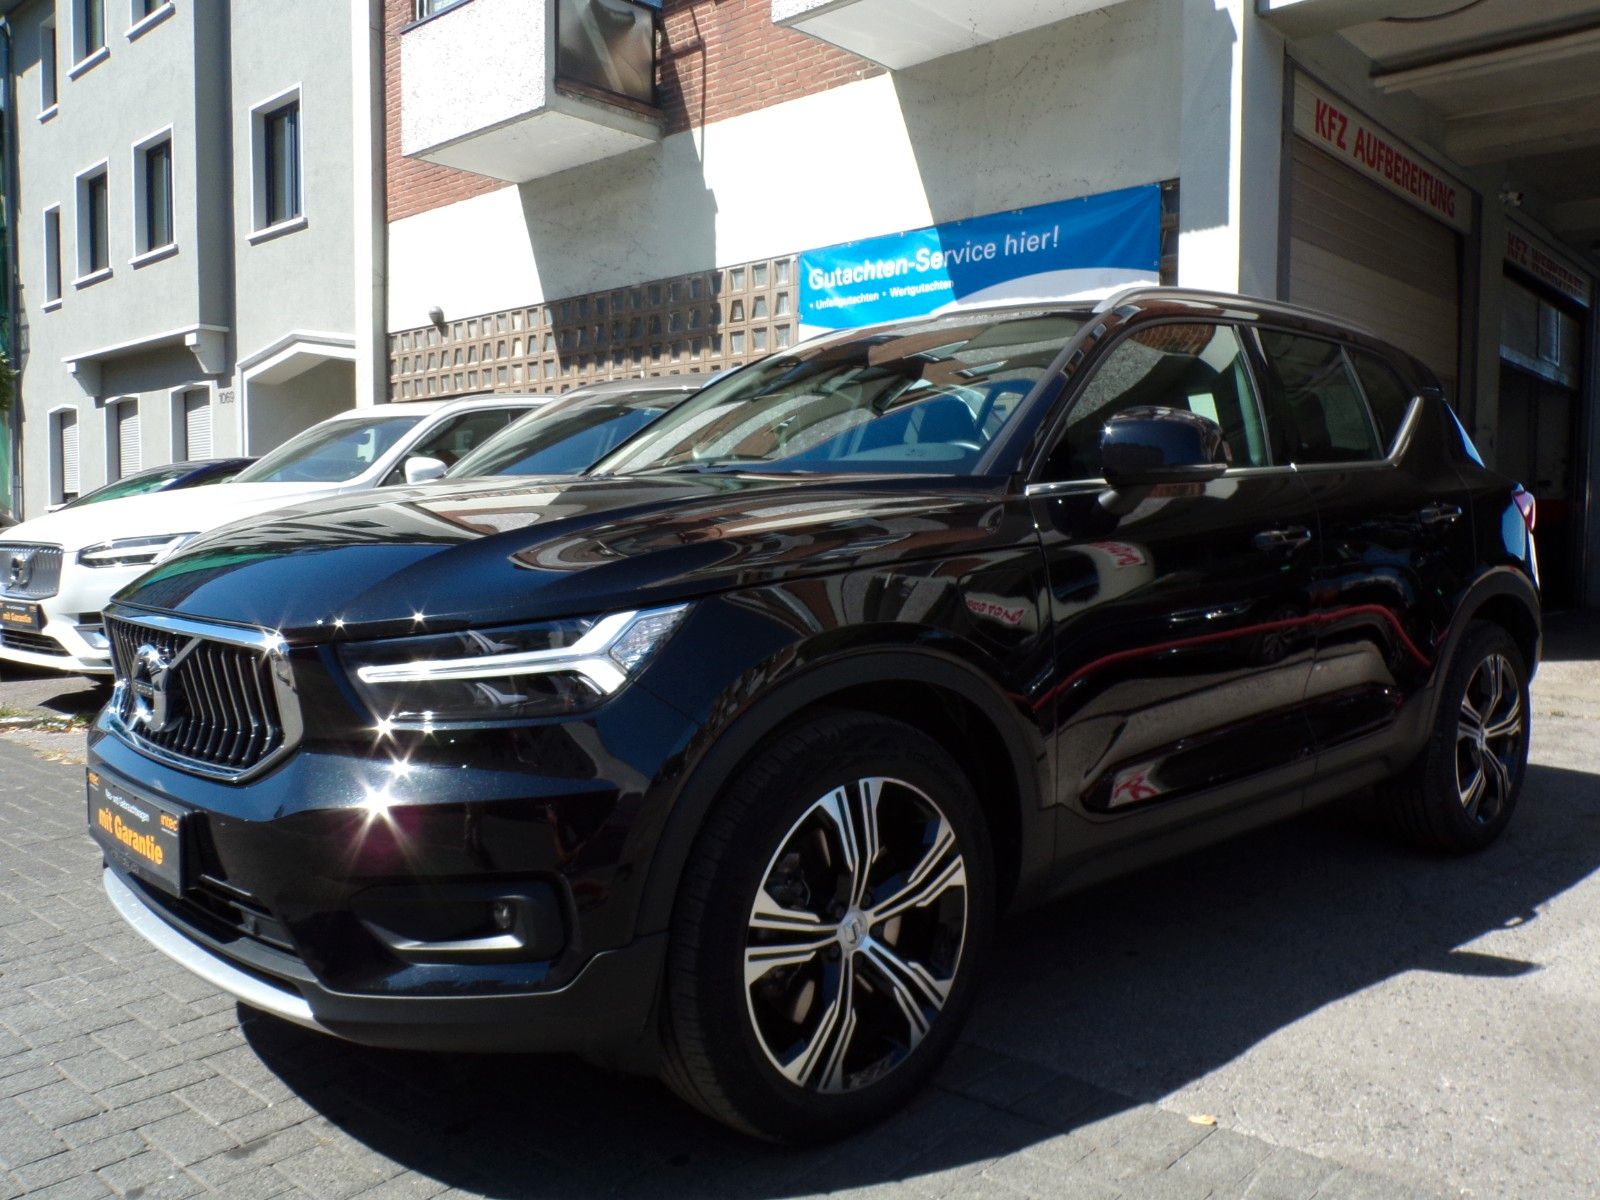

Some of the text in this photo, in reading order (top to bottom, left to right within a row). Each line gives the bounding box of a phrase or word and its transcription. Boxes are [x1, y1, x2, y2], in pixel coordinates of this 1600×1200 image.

[1315, 98, 1456, 218] KFZ AUFBEREITUNG
[809, 224, 1059, 290] Gutachten-Service hier!
[889, 280, 954, 298] Wertgutachten
[98, 808, 113, 833] mit
[114, 814, 163, 865] Garantie
